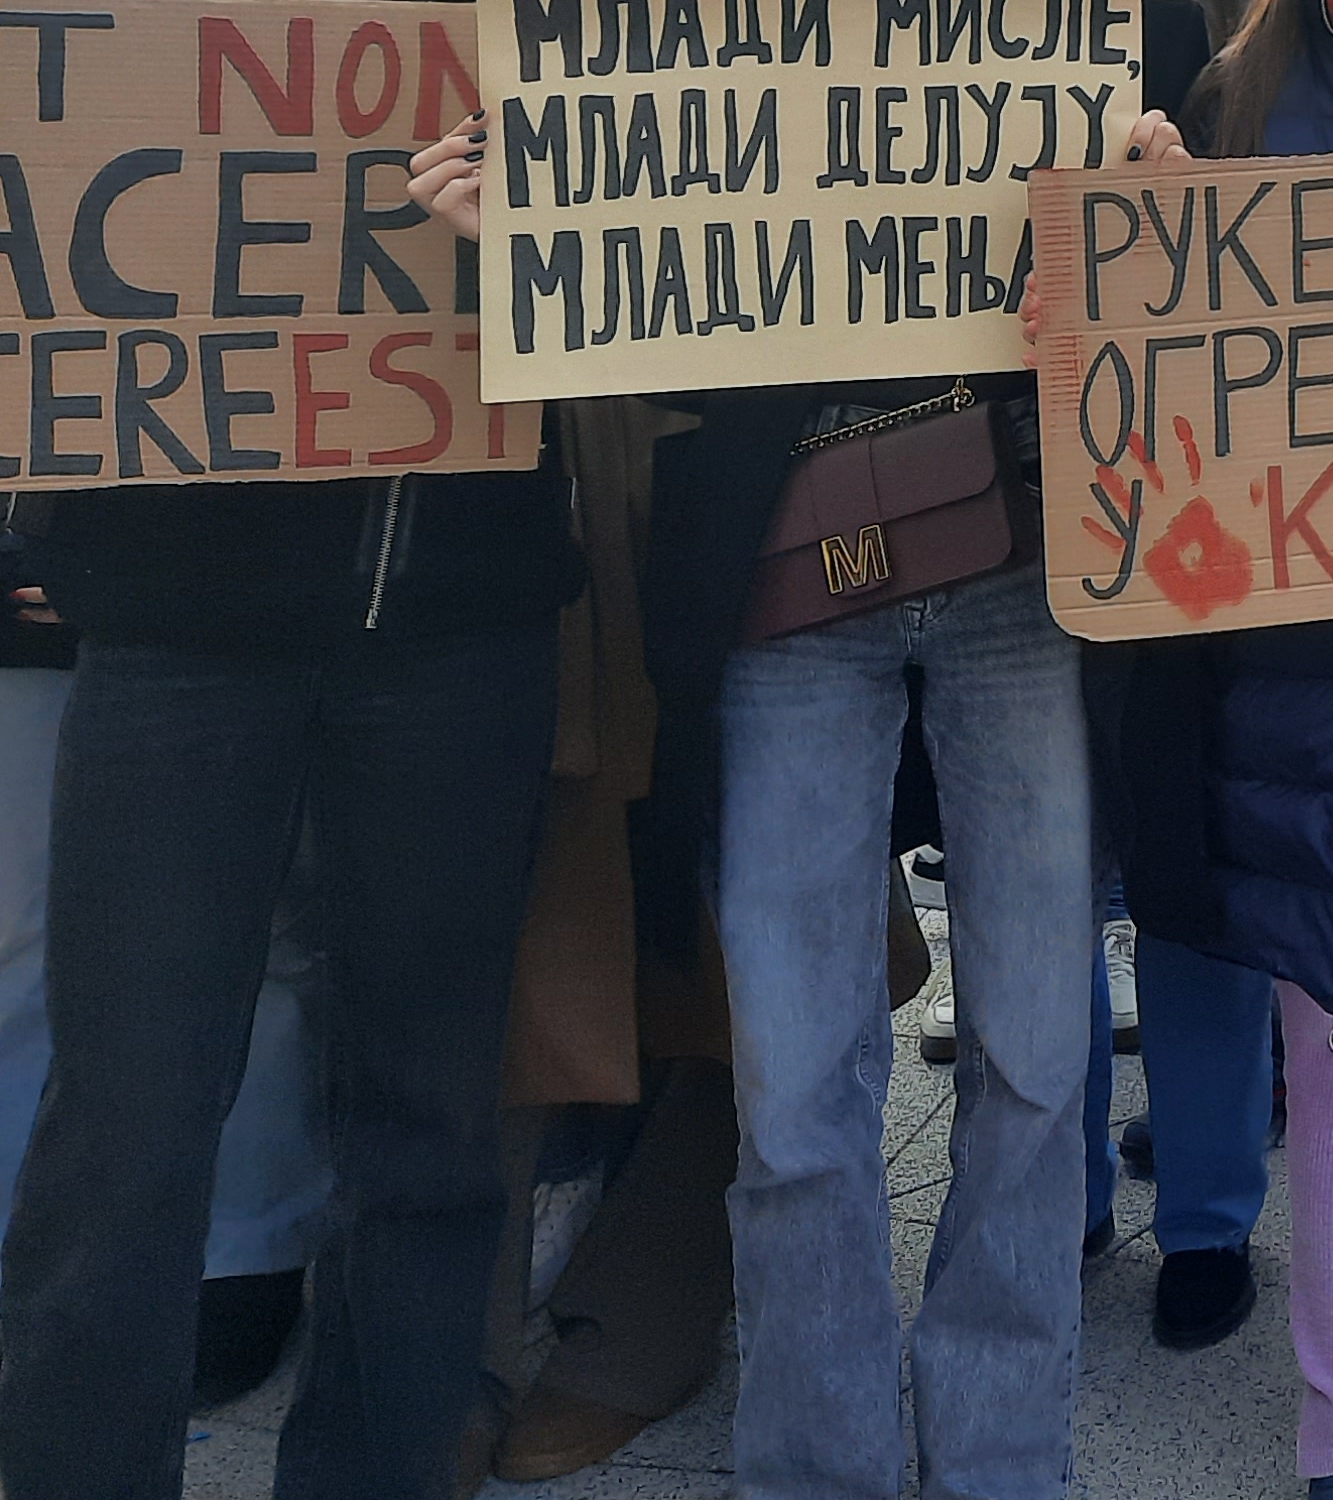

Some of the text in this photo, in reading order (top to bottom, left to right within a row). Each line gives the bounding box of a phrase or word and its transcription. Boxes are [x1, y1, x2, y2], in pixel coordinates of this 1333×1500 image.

[502, 82, 1115, 208] МЛАДИ ДЕЛУЈУ
[510, 219, 814, 354] МЛАДИ
[820, 523, 890, 595] M
[1082, 479, 1144, 600] У
